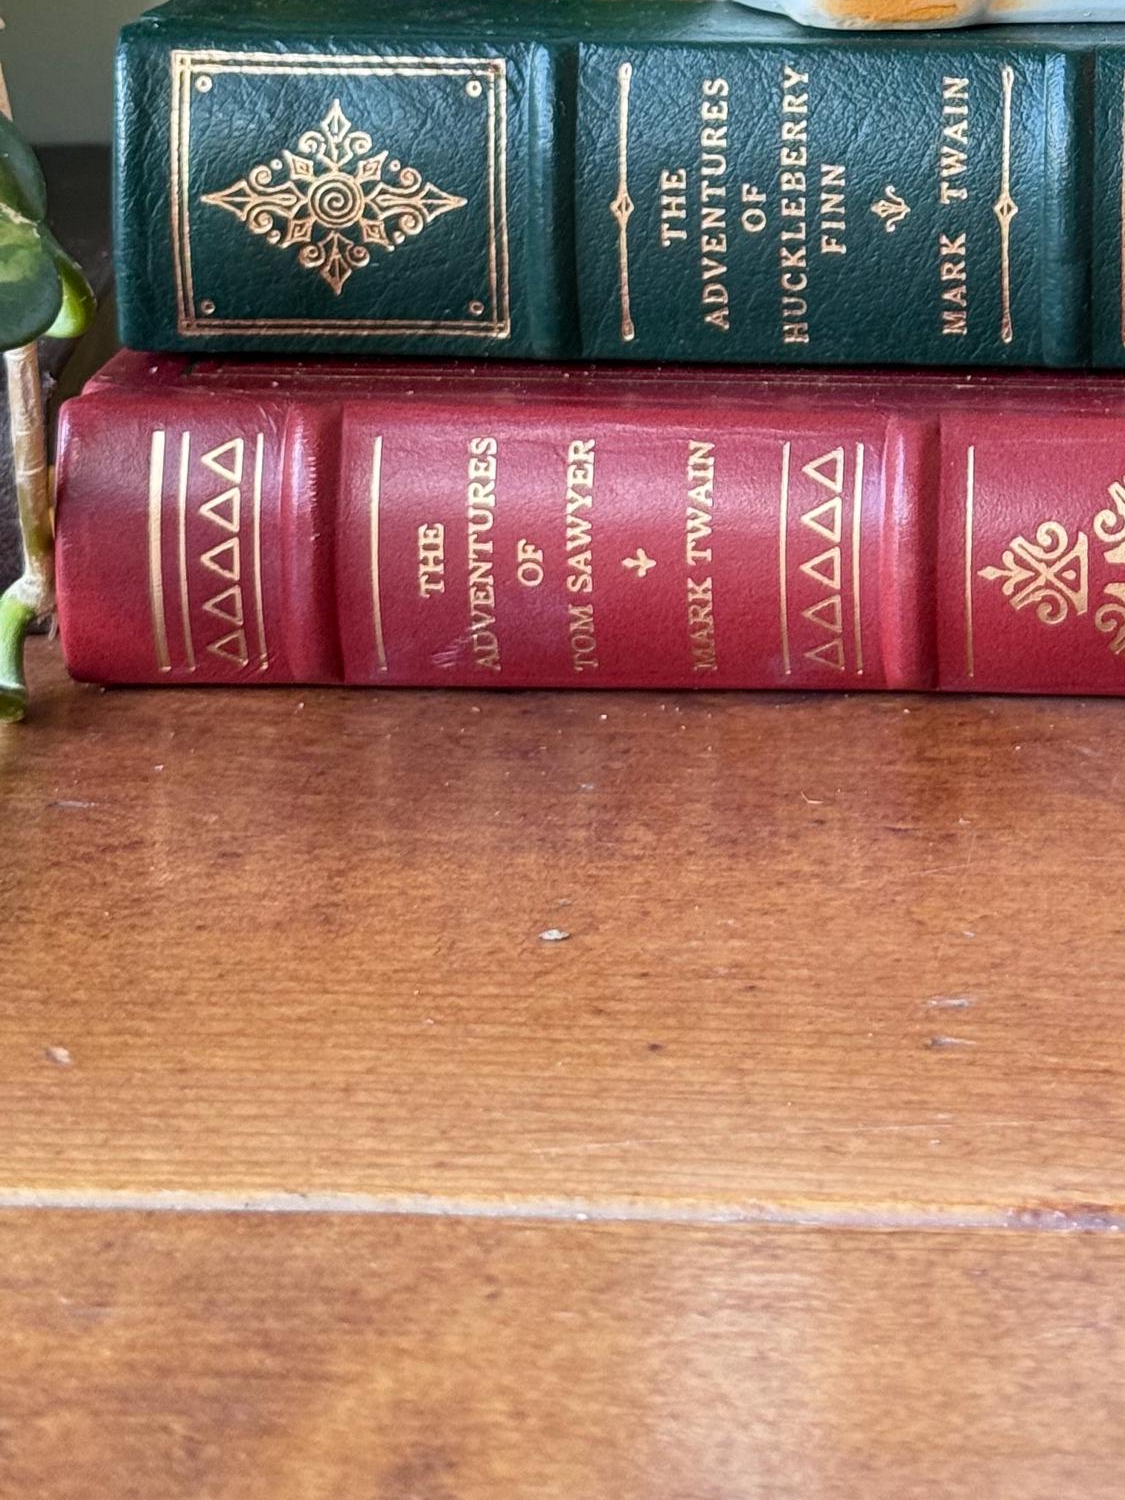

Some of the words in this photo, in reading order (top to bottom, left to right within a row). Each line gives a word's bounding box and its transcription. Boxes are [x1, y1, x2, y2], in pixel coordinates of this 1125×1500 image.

[939, 76, 970, 205] TWAIN
[661, 167, 687, 248] THE
[700, 77, 730, 331] ADVENTURES
[740, 183, 767, 233] OF
[780, 65, 810, 344] HUCKLEBERRY
[821, 163, 847, 254] FINN
[939, 232, 968, 337] MARK
[565, 439, 596, 593] SAWYER
[686, 439, 716, 563] TWAIN
[417, 522, 445, 598] THE
[467, 435, 501, 671] ADVENTURES
[517, 539, 545, 587] OF
[569, 604, 597, 671] TOM
[686, 577, 717, 671] MARK
